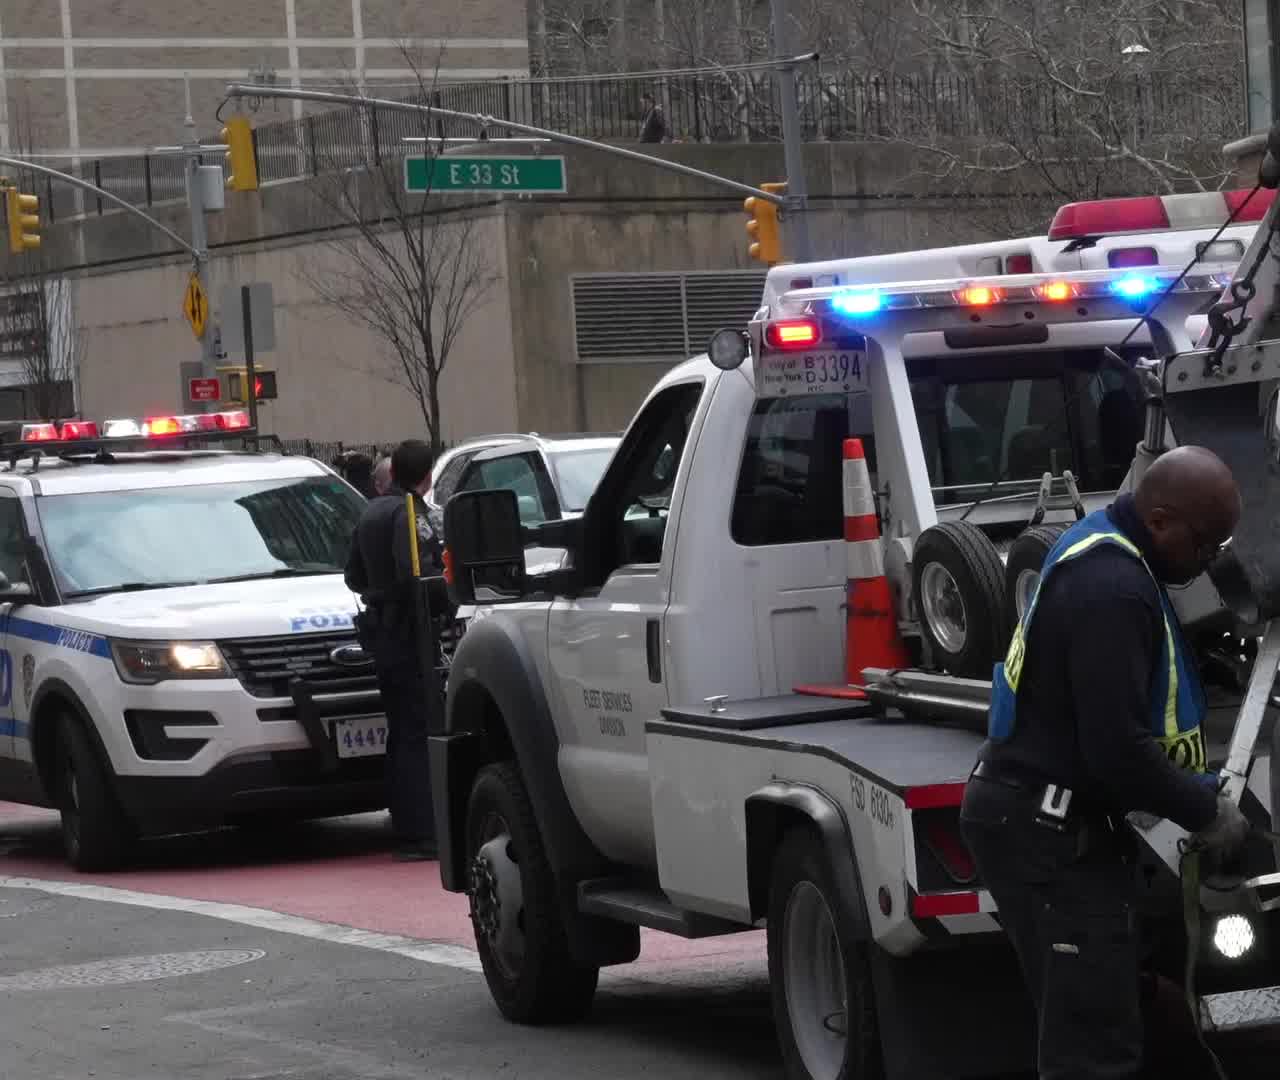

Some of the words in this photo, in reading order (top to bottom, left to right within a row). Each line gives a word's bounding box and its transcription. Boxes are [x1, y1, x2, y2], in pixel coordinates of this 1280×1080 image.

[450, 164, 462, 184] E
[469, 164, 492, 184] 33
[501, 164, 520, 184] St
[816, 353, 861, 383] 3394
